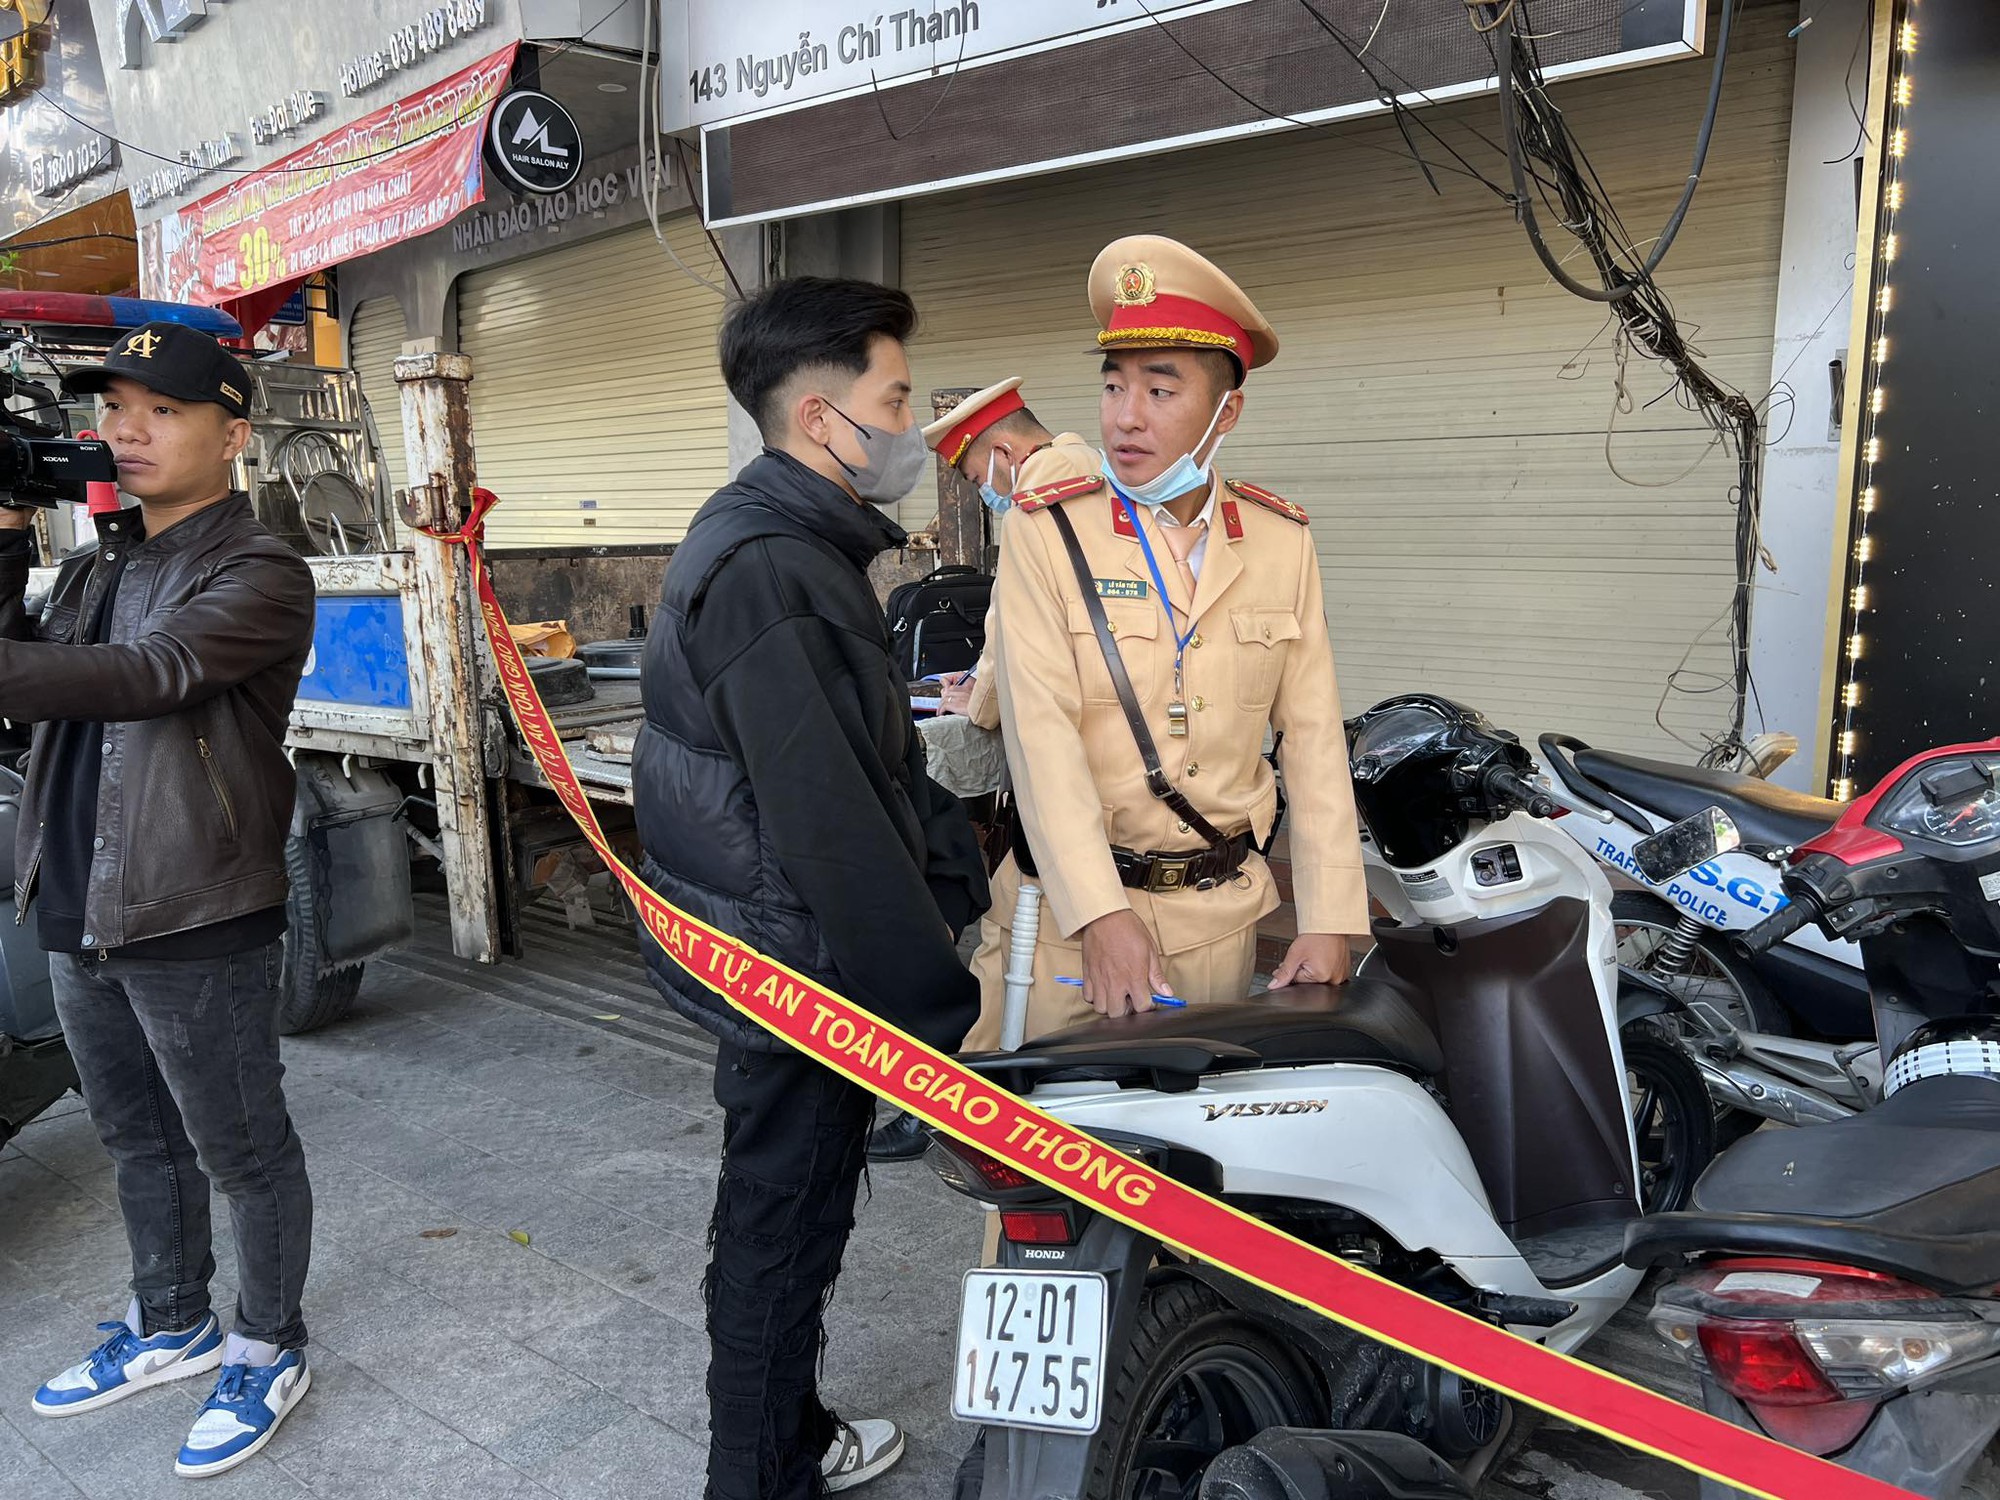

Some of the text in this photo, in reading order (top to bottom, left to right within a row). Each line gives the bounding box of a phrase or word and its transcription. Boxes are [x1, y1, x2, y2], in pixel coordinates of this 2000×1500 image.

[339, 50, 388, 98] Hotline:
[390, 25, 415, 69] 039
[418, 12, 444, 53] 489
[689, 0, 979, 104] 143 Nguyễn Chí Thanh
[290, 89, 316, 124] Blue
[46, 136, 101, 188] 1800 1051
[511, 153, 570, 171] HAIR SALON ALY
[575, 172, 619, 215] HỌC
[626, 150, 671, 198] VÊN
[240, 226, 286, 289] 30%
[496, 642, 522, 680] GIAO
[1596, 837, 1728, 927] TRAF POLICE
[644, 900, 1157, 1207] TRẬT TỰ, AN TOÀN GIAO THÔNG
[1200, 1099, 1328, 1121] VISION
[986, 1282, 1077, 1346] 12-D1
[967, 1348, 1091, 1420] 147.55
